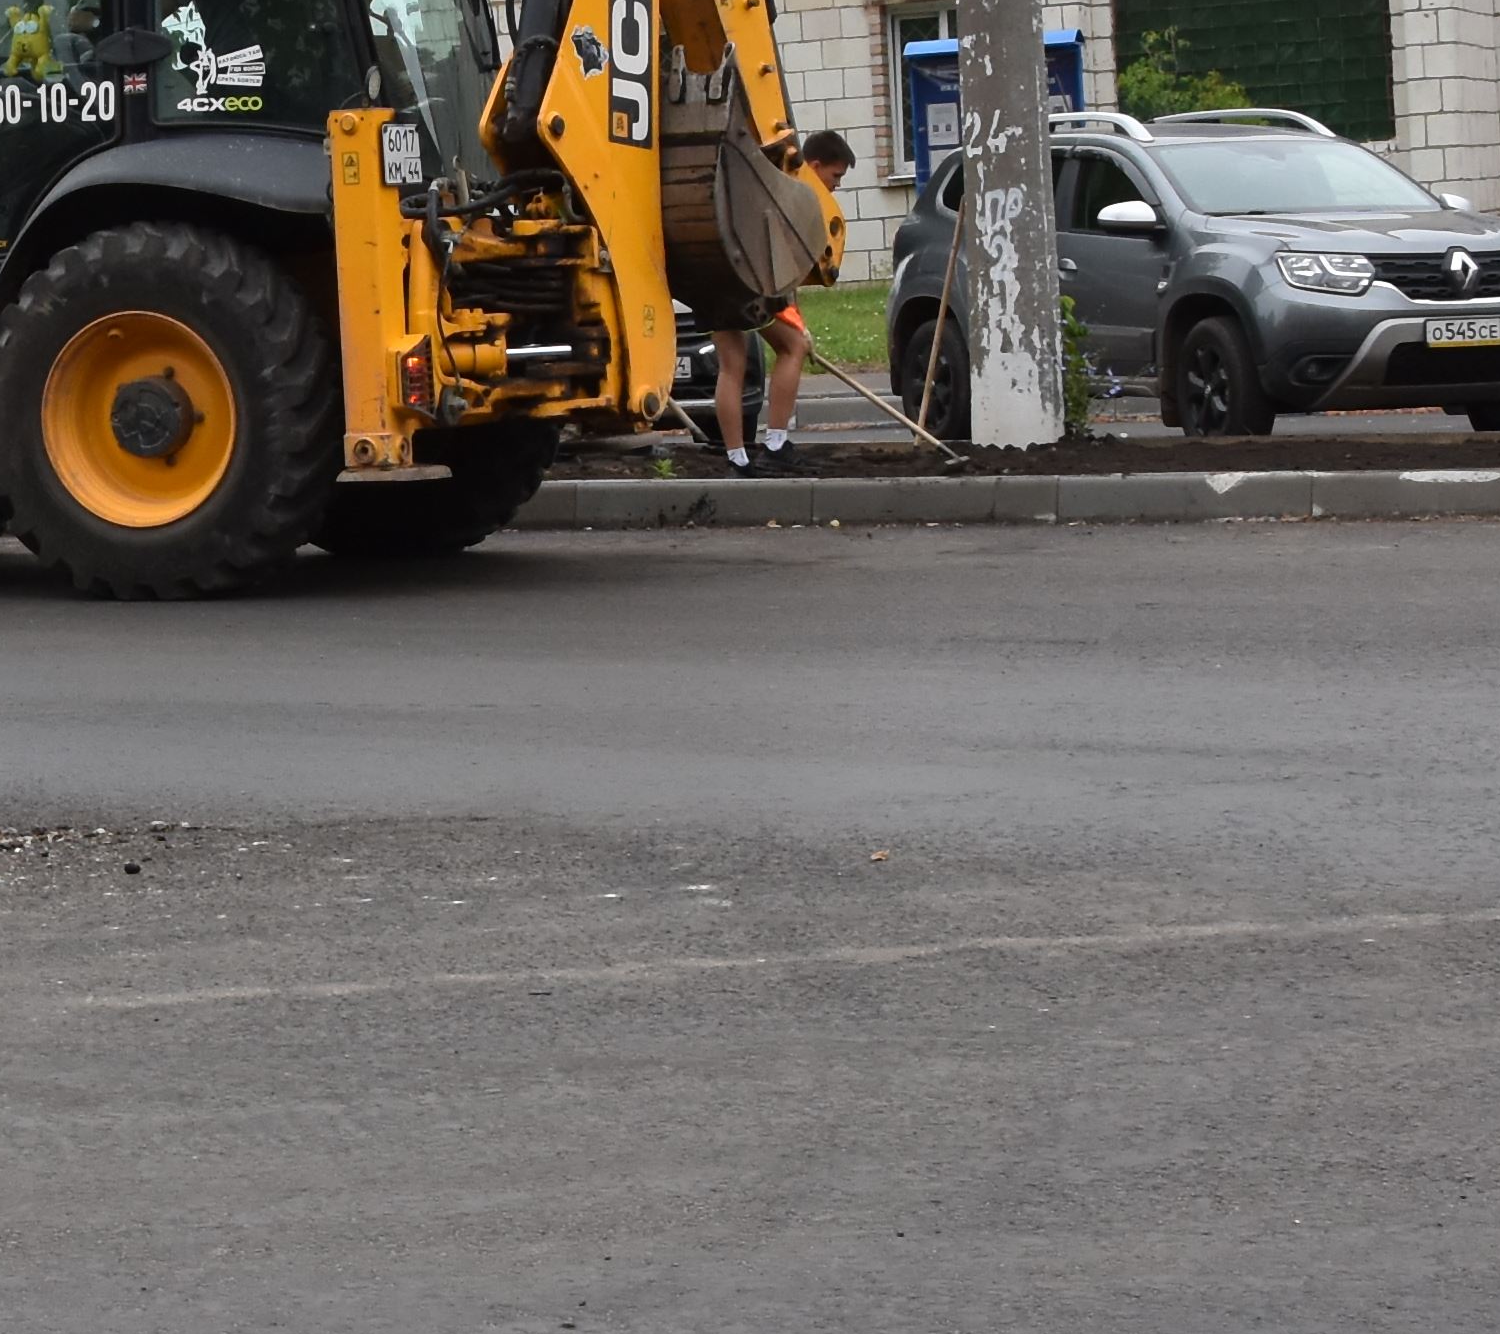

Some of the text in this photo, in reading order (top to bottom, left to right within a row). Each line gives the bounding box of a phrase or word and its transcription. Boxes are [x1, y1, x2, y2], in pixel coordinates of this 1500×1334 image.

[388, 130, 415, 152] 6017
[388, 162, 420, 180] КМ 44
